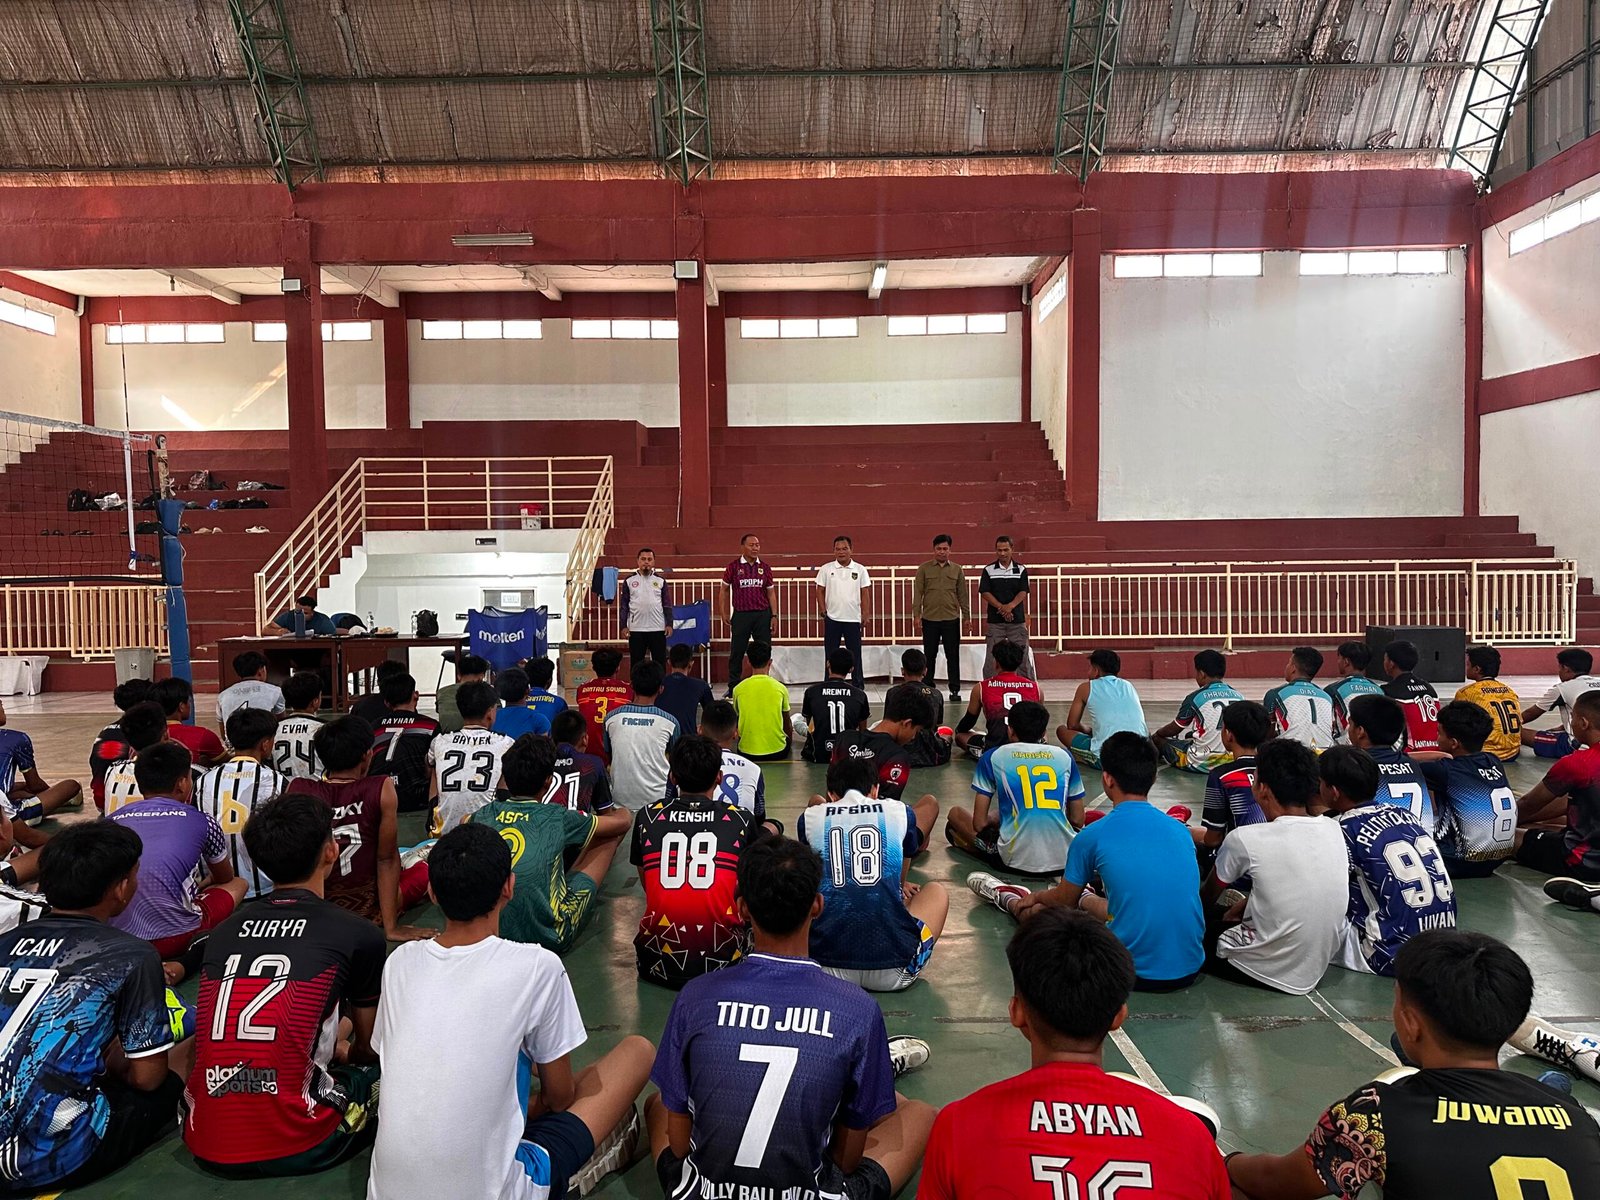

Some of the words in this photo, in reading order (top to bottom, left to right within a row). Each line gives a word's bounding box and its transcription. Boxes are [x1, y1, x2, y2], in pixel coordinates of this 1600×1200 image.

[478, 628, 525, 643] molten
[1350, 684, 1378, 693] FARHAN
[381, 717, 415, 725] RAYHAN
[594, 697, 608, 724] 3
[828, 701, 845, 734] 11
[1308, 698, 1318, 725] 1
[1414, 694, 1438, 723] 18
[1490, 700, 1521, 735] 16
[282, 724, 308, 734] EVAN
[385, 727, 404, 761] 7
[452, 735, 491, 746] BAYYEN
[274, 740, 315, 776] 24
[441, 750, 495, 792] 23
[1378, 763, 1414, 775] PESAT
[1016, 765, 1061, 809] 12
[1388, 783, 1423, 822] 7
[112, 810, 187, 820] TANGERANG
[669, 805, 715, 822] KENSHI
[825, 803, 884, 817] AFGAN
[1490, 786, 1518, 842] 8
[331, 823, 362, 877] 7
[660, 832, 718, 889] 08
[828, 824, 882, 888] 18
[1383, 834, 1455, 909] 93
[238, 919, 307, 938] SURYA
[9, 938, 64, 957] ICAN
[0, 967, 59, 1062] 7
[211, 954, 292, 1041] 12
[717, 1001, 770, 1030] TITO
[774, 1007, 834, 1038] JULL
[733, 1043, 799, 1169] 7
[1029, 1100, 1144, 1137] ABYAN
[1432, 1096, 1573, 1130] juwangi
